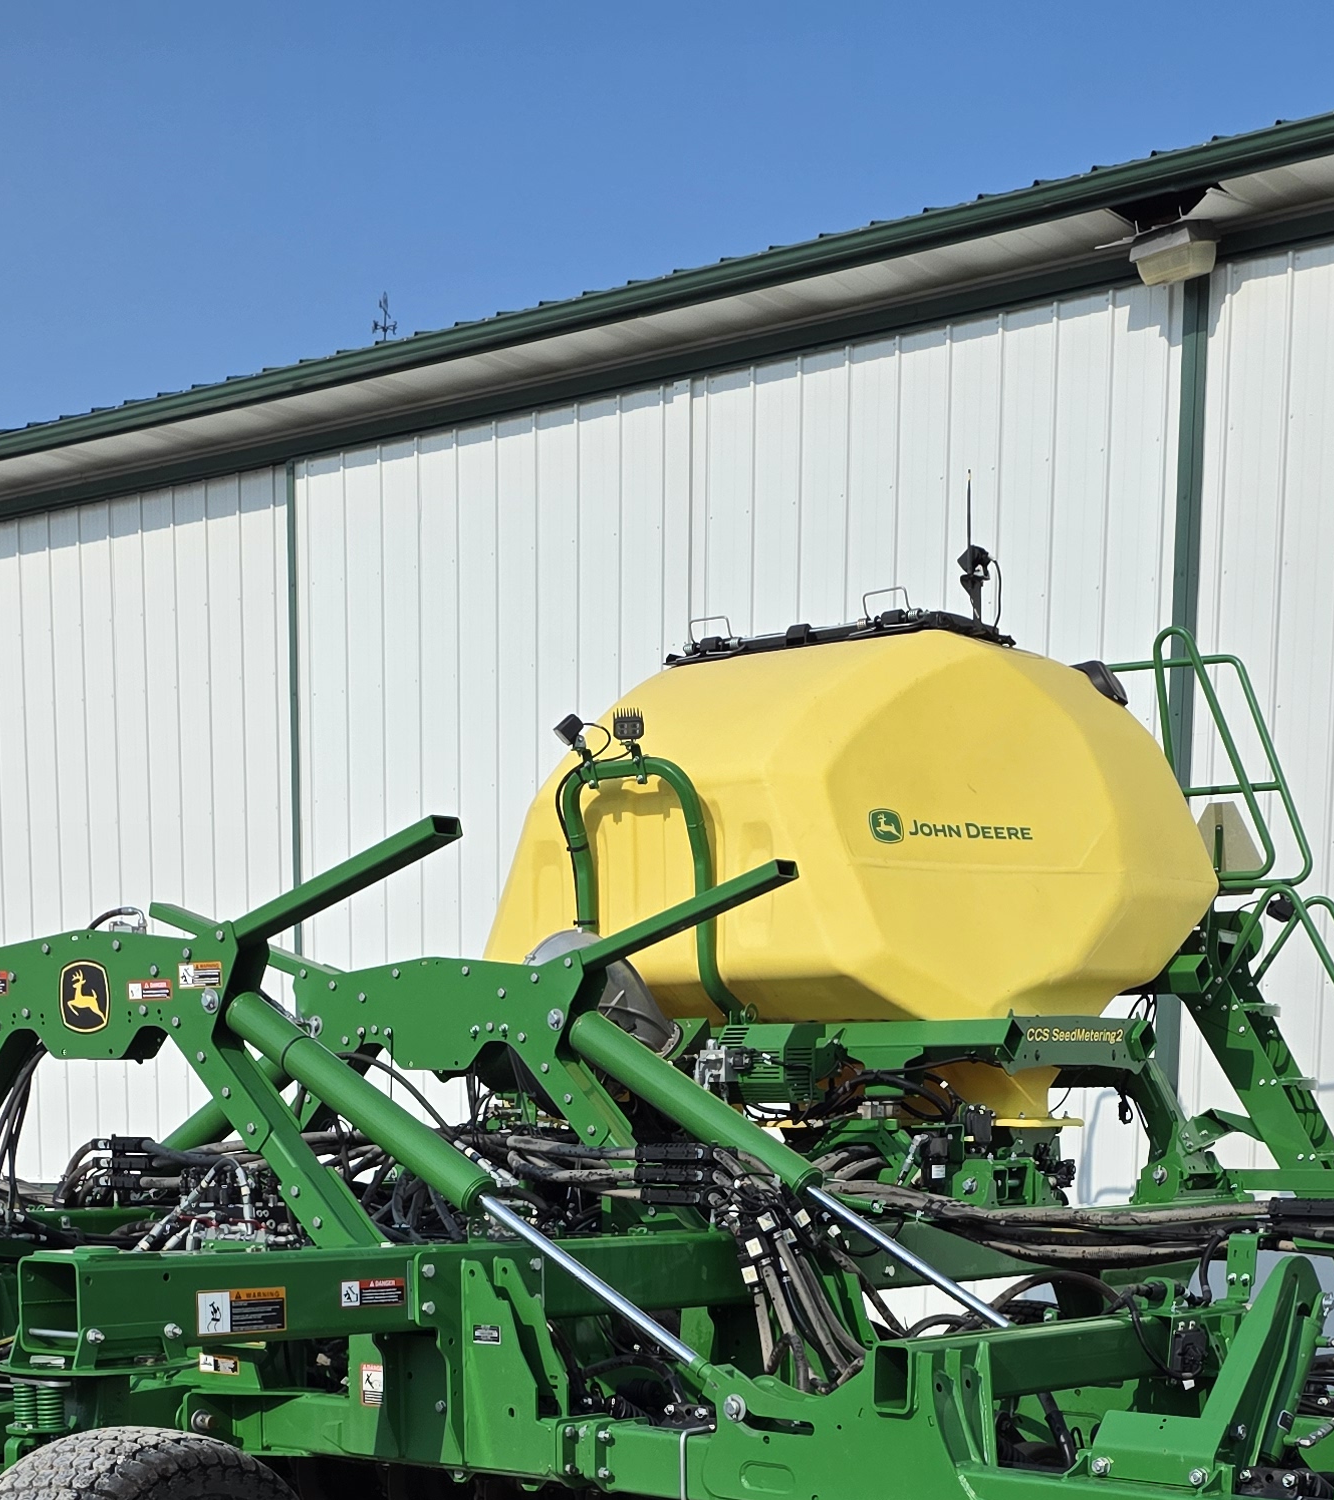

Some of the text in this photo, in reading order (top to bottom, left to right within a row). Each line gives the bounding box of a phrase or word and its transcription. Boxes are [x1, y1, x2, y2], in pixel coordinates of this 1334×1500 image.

[909, 819, 1033, 840] JOHN DEERE
[1027, 1028, 1124, 1045] CCS SeedMetering2
[245, 1290, 281, 1299] WARNING
